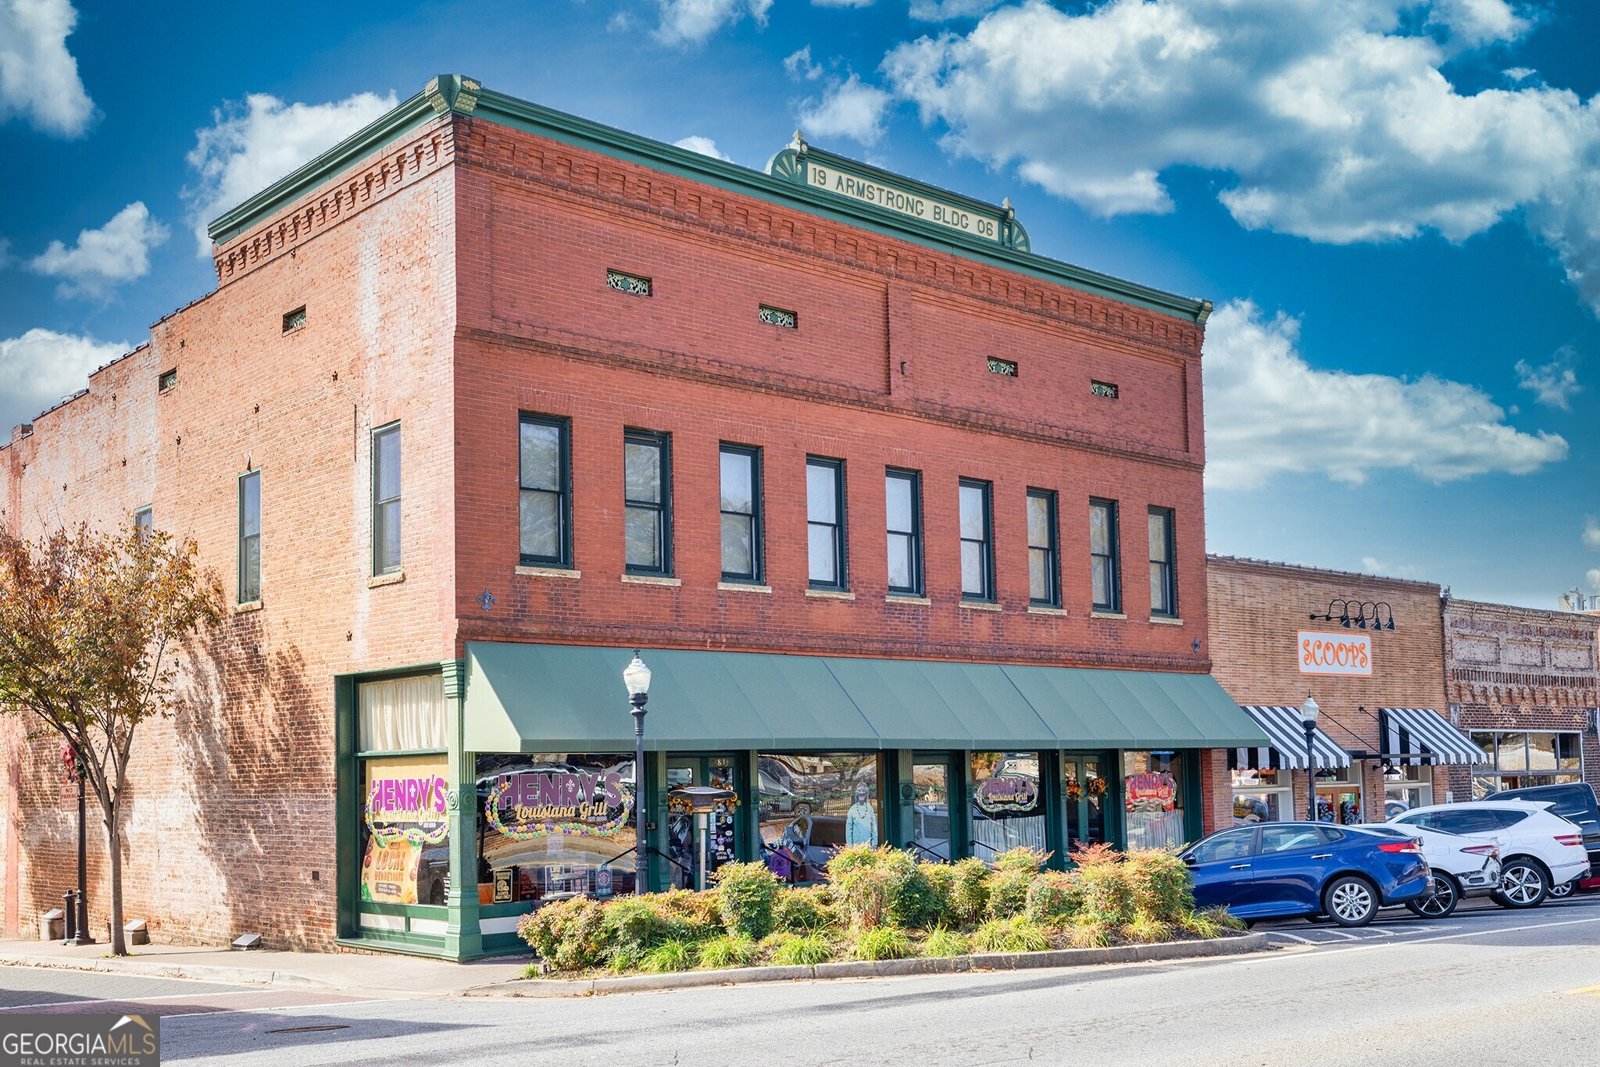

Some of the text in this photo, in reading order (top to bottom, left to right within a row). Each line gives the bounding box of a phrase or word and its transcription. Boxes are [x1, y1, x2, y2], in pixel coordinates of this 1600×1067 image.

[812, 167, 994, 237] 19 ARMSTRONG BLDG 06
[1303, 639, 1368, 668] SCOOPS
[371, 774, 446, 813] HENRY'S
[498, 769, 622, 810] HENRY'S
[514, 800, 608, 824] Louisiana Grill
